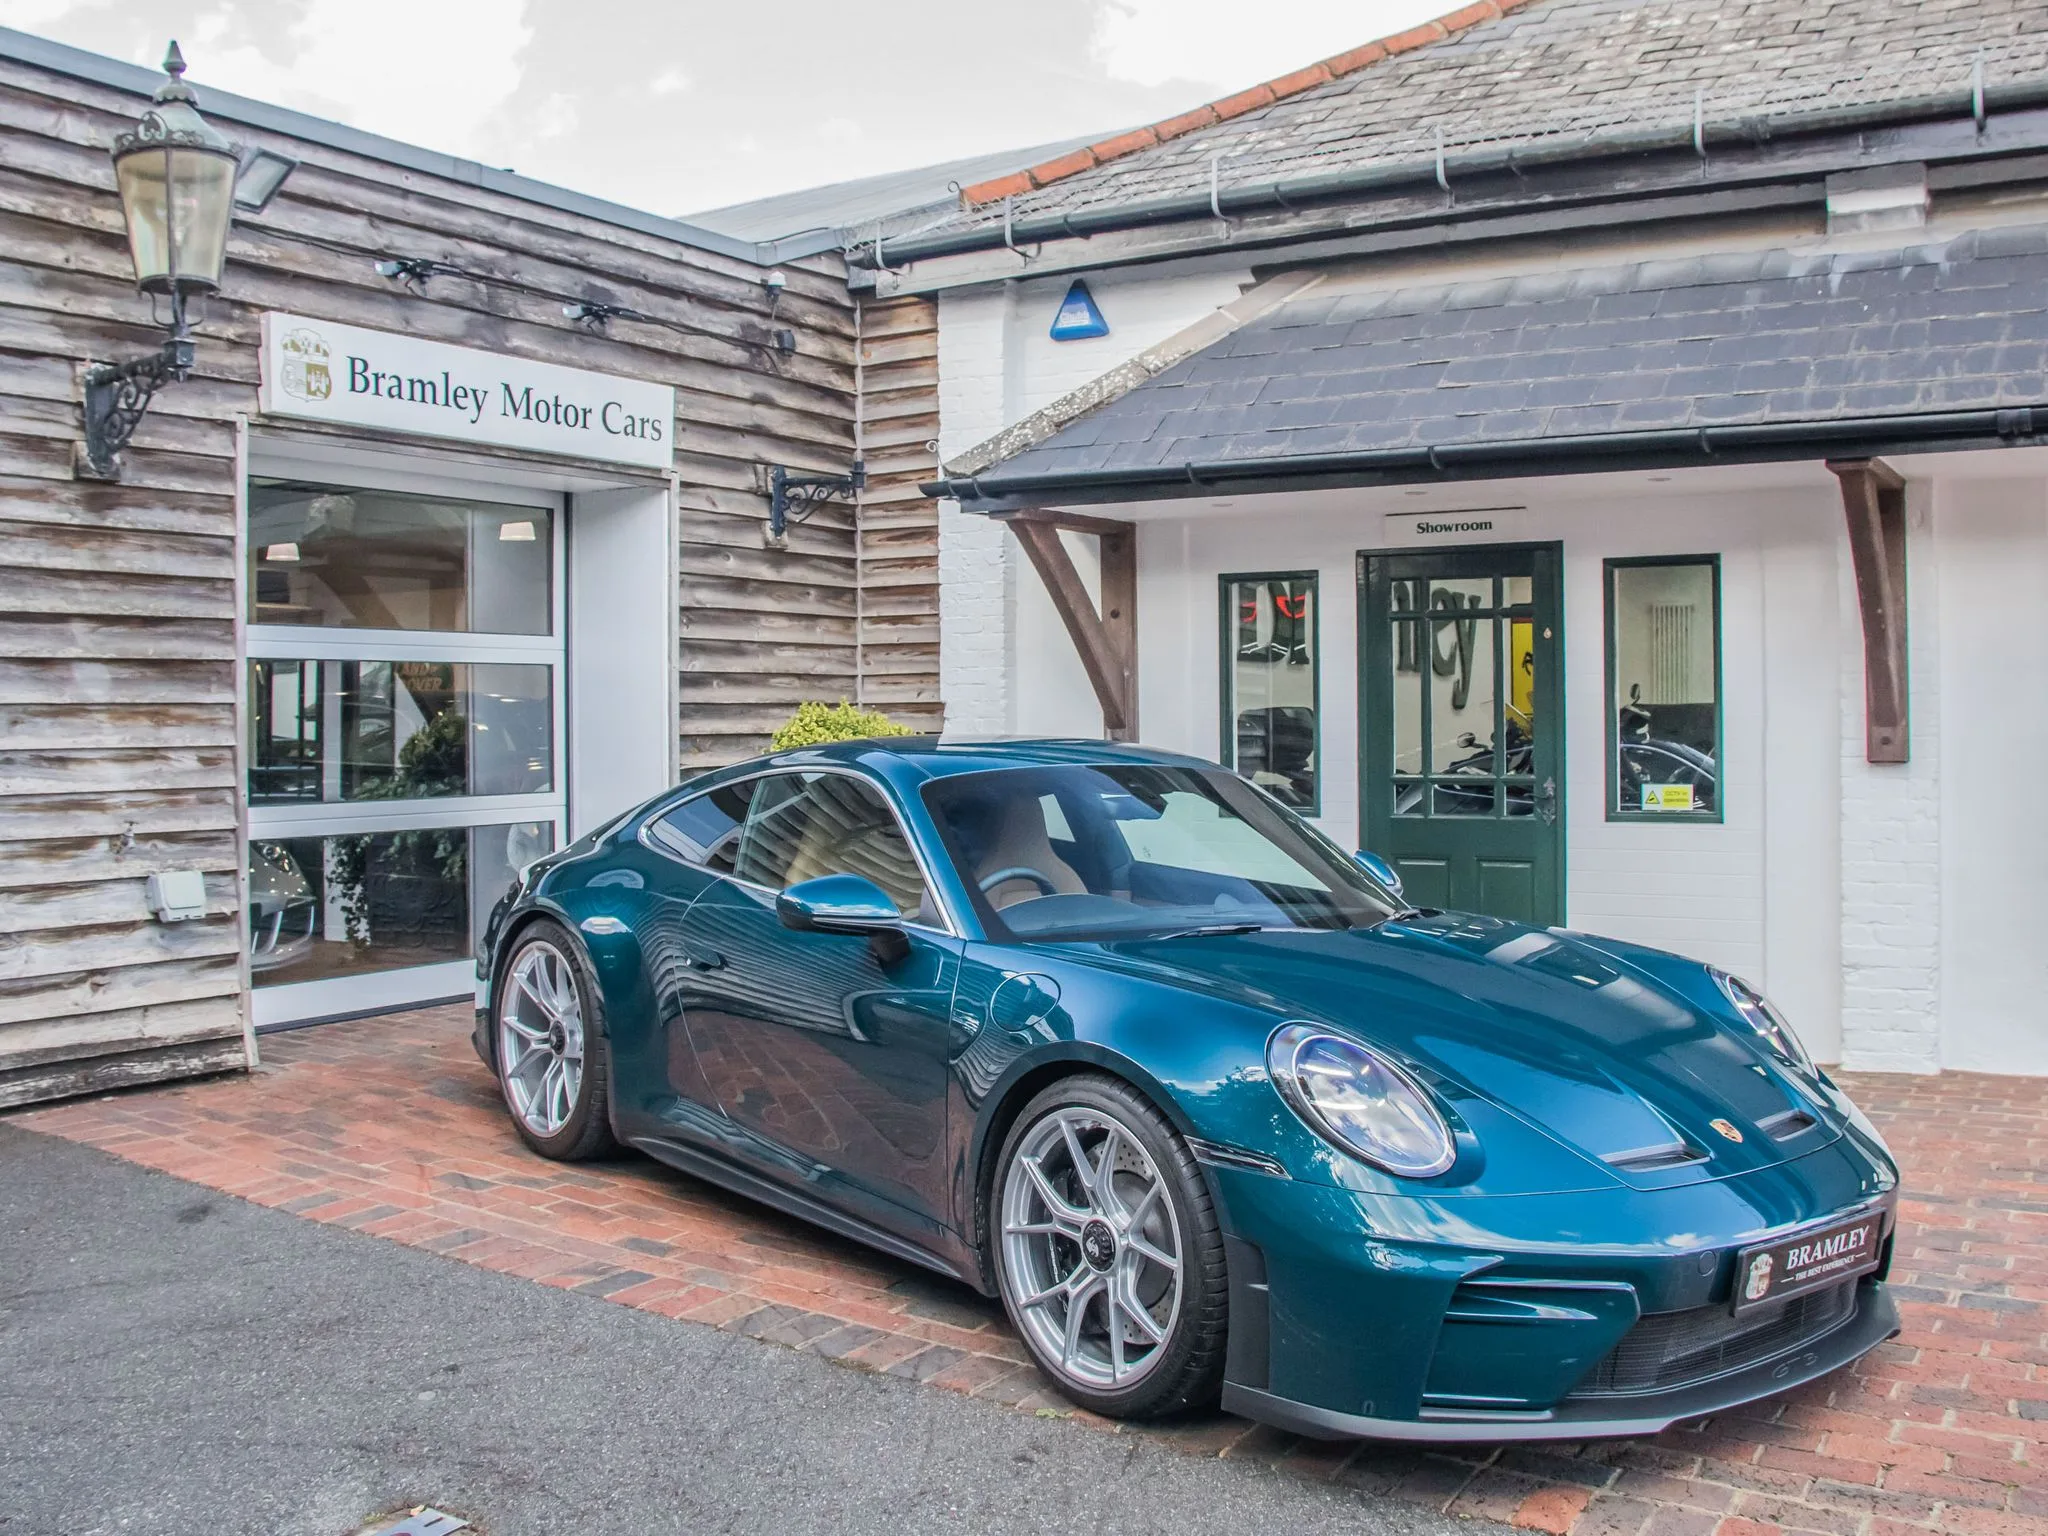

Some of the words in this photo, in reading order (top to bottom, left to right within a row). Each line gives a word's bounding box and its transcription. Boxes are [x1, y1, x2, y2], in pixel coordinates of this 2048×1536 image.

[346, 355, 488, 424] Bramley
[500, 382, 593, 430] Motor
[602, 401, 663, 442] Cars
[1416, 520, 1493, 534] Showroom
[1786, 1225, 1870, 1271] BRAMLEY
